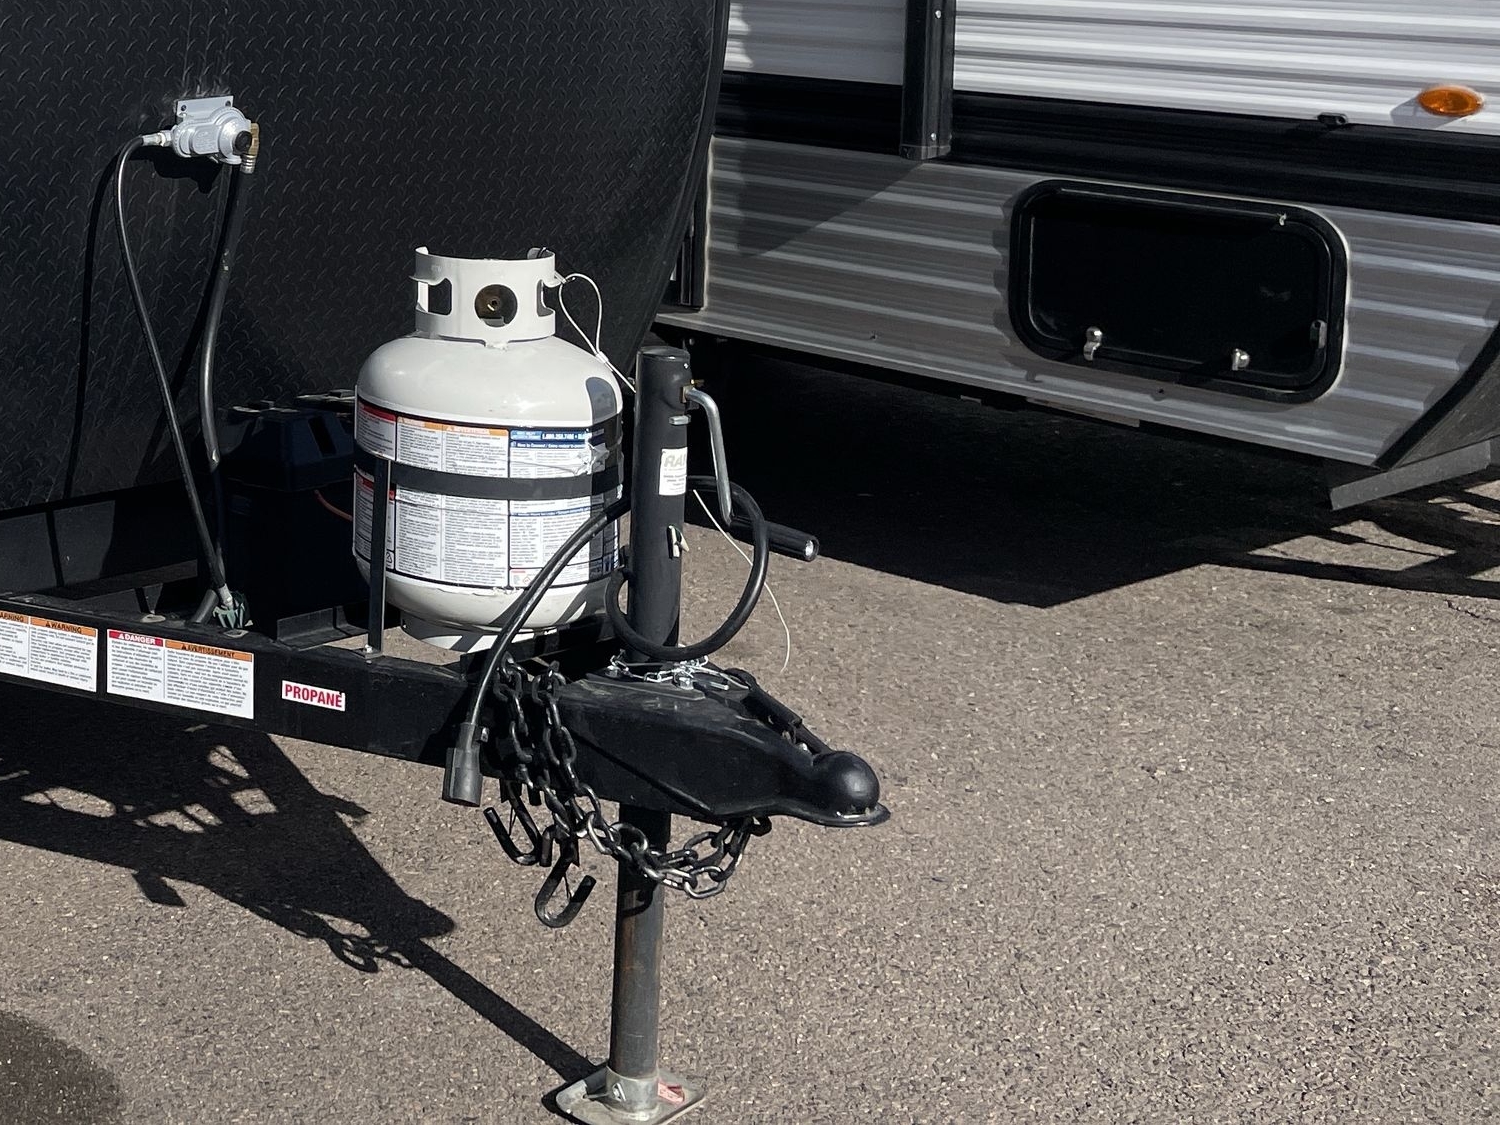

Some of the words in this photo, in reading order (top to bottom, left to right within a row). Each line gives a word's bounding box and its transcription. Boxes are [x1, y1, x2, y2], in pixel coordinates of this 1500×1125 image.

[664, 455, 686, 467] RA
[52, 622, 82, 634] WARNING
[125, 634, 156, 645] DANGER
[285, 684, 342, 708] PROPANE
